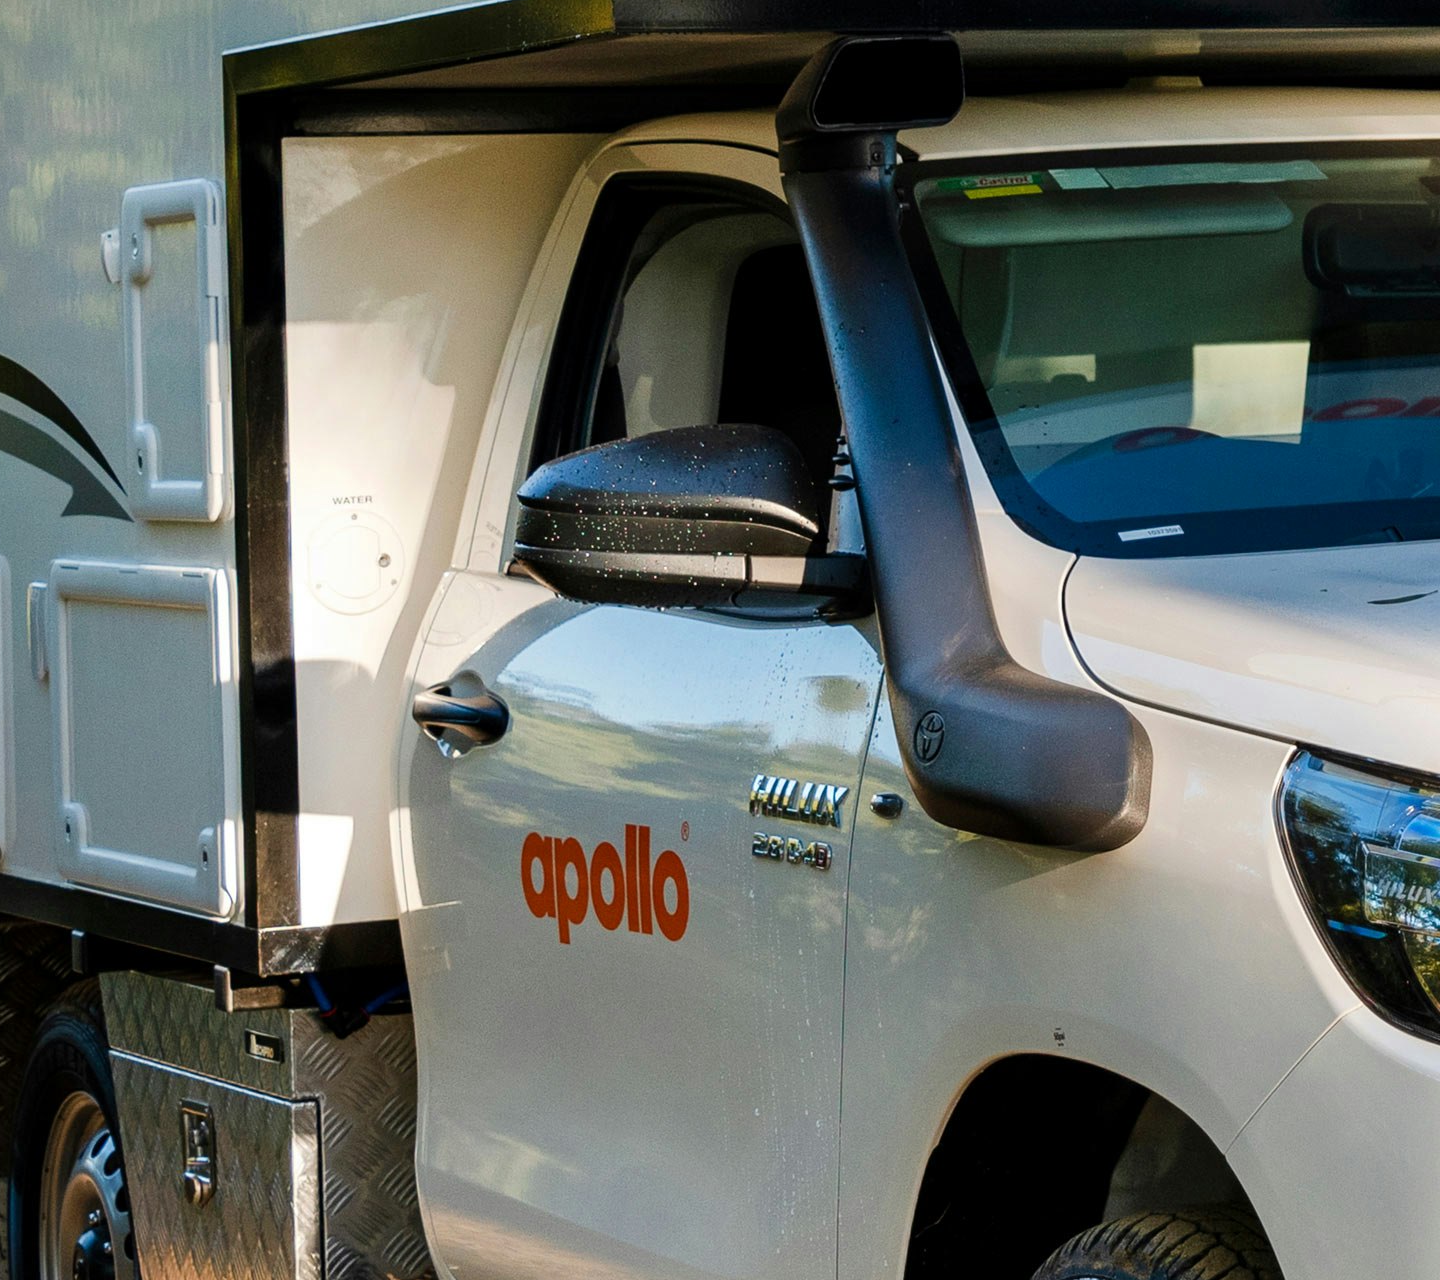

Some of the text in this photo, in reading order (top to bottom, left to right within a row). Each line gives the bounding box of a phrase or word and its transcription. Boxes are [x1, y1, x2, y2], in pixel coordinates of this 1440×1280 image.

[978, 176, 1028, 186] Castrol
[332, 495, 373, 505] WATER
[750, 774, 849, 828] HILUX
[520, 823, 690, 945] apollo
[1377, 879, 1438, 906] HILUX
